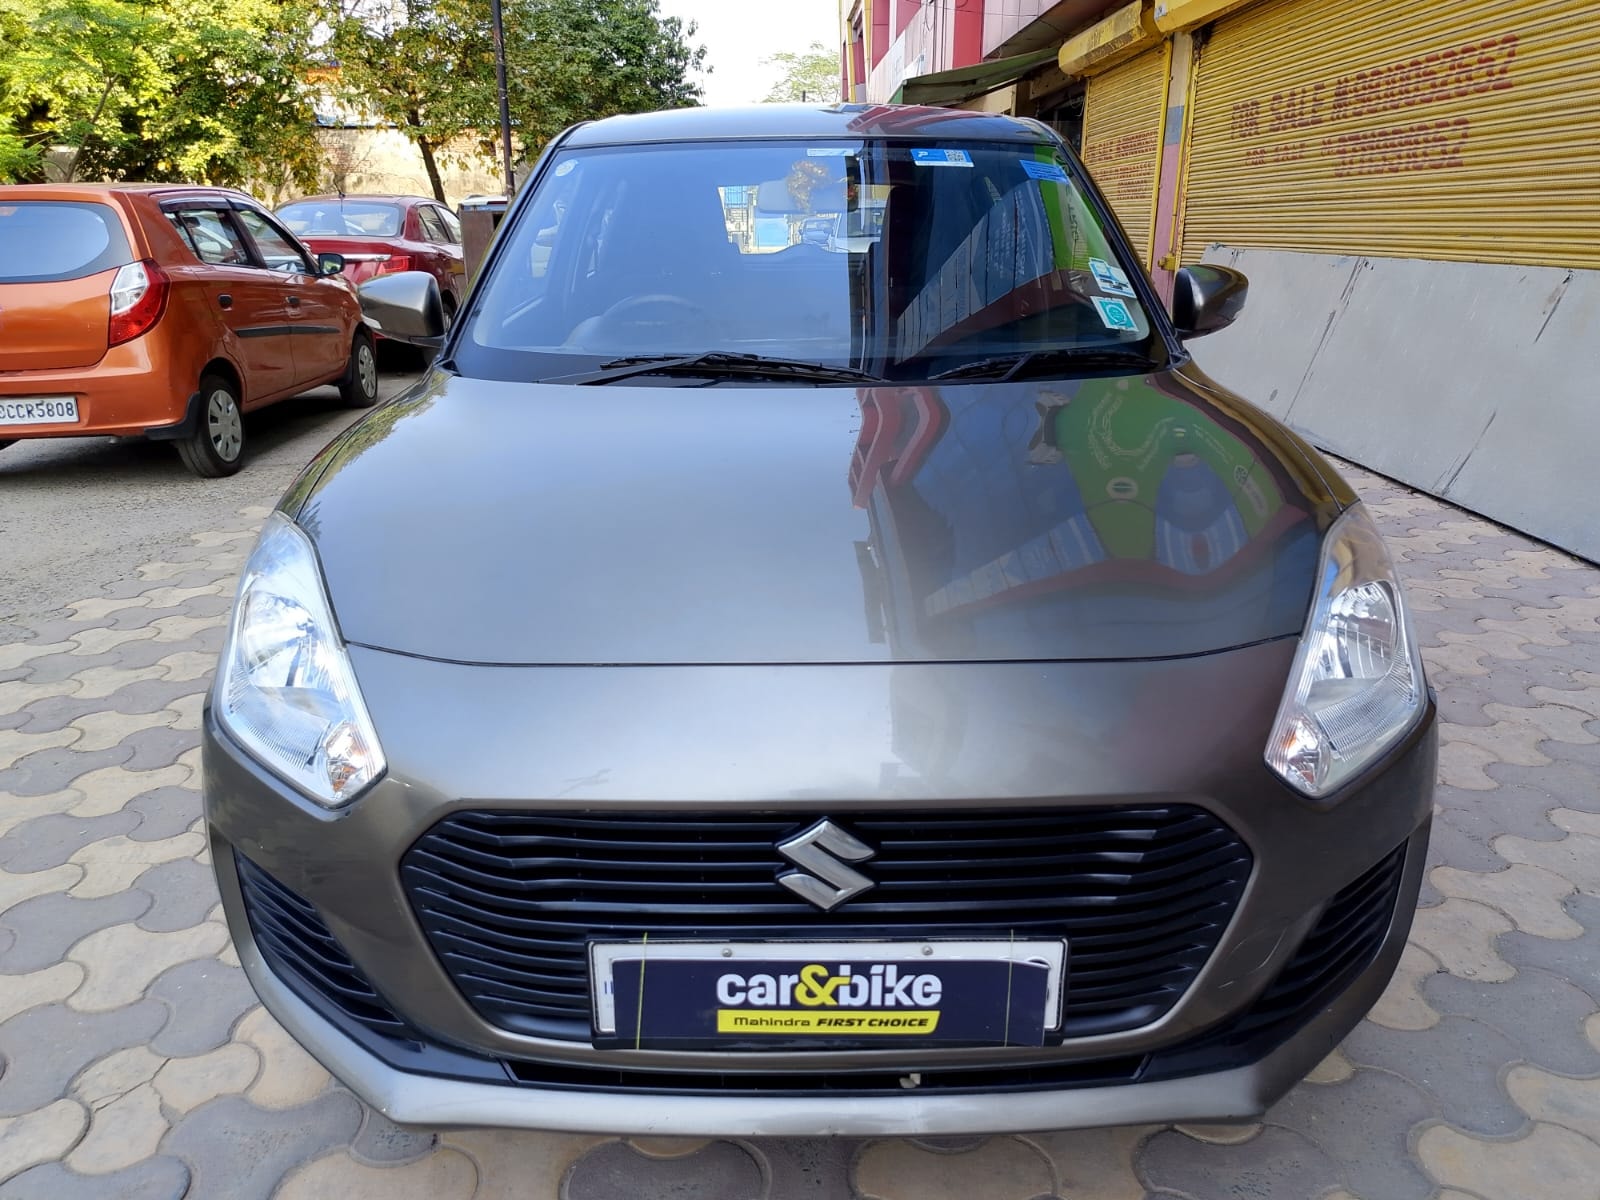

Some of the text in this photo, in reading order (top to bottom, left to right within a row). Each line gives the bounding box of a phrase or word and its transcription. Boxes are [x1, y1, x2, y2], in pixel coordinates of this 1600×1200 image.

[1269, 83, 1326, 133] SALE
[716, 964, 943, 1006] car&bike
[733, 1016, 929, 1027] Mahindra FIRST CHOICE
